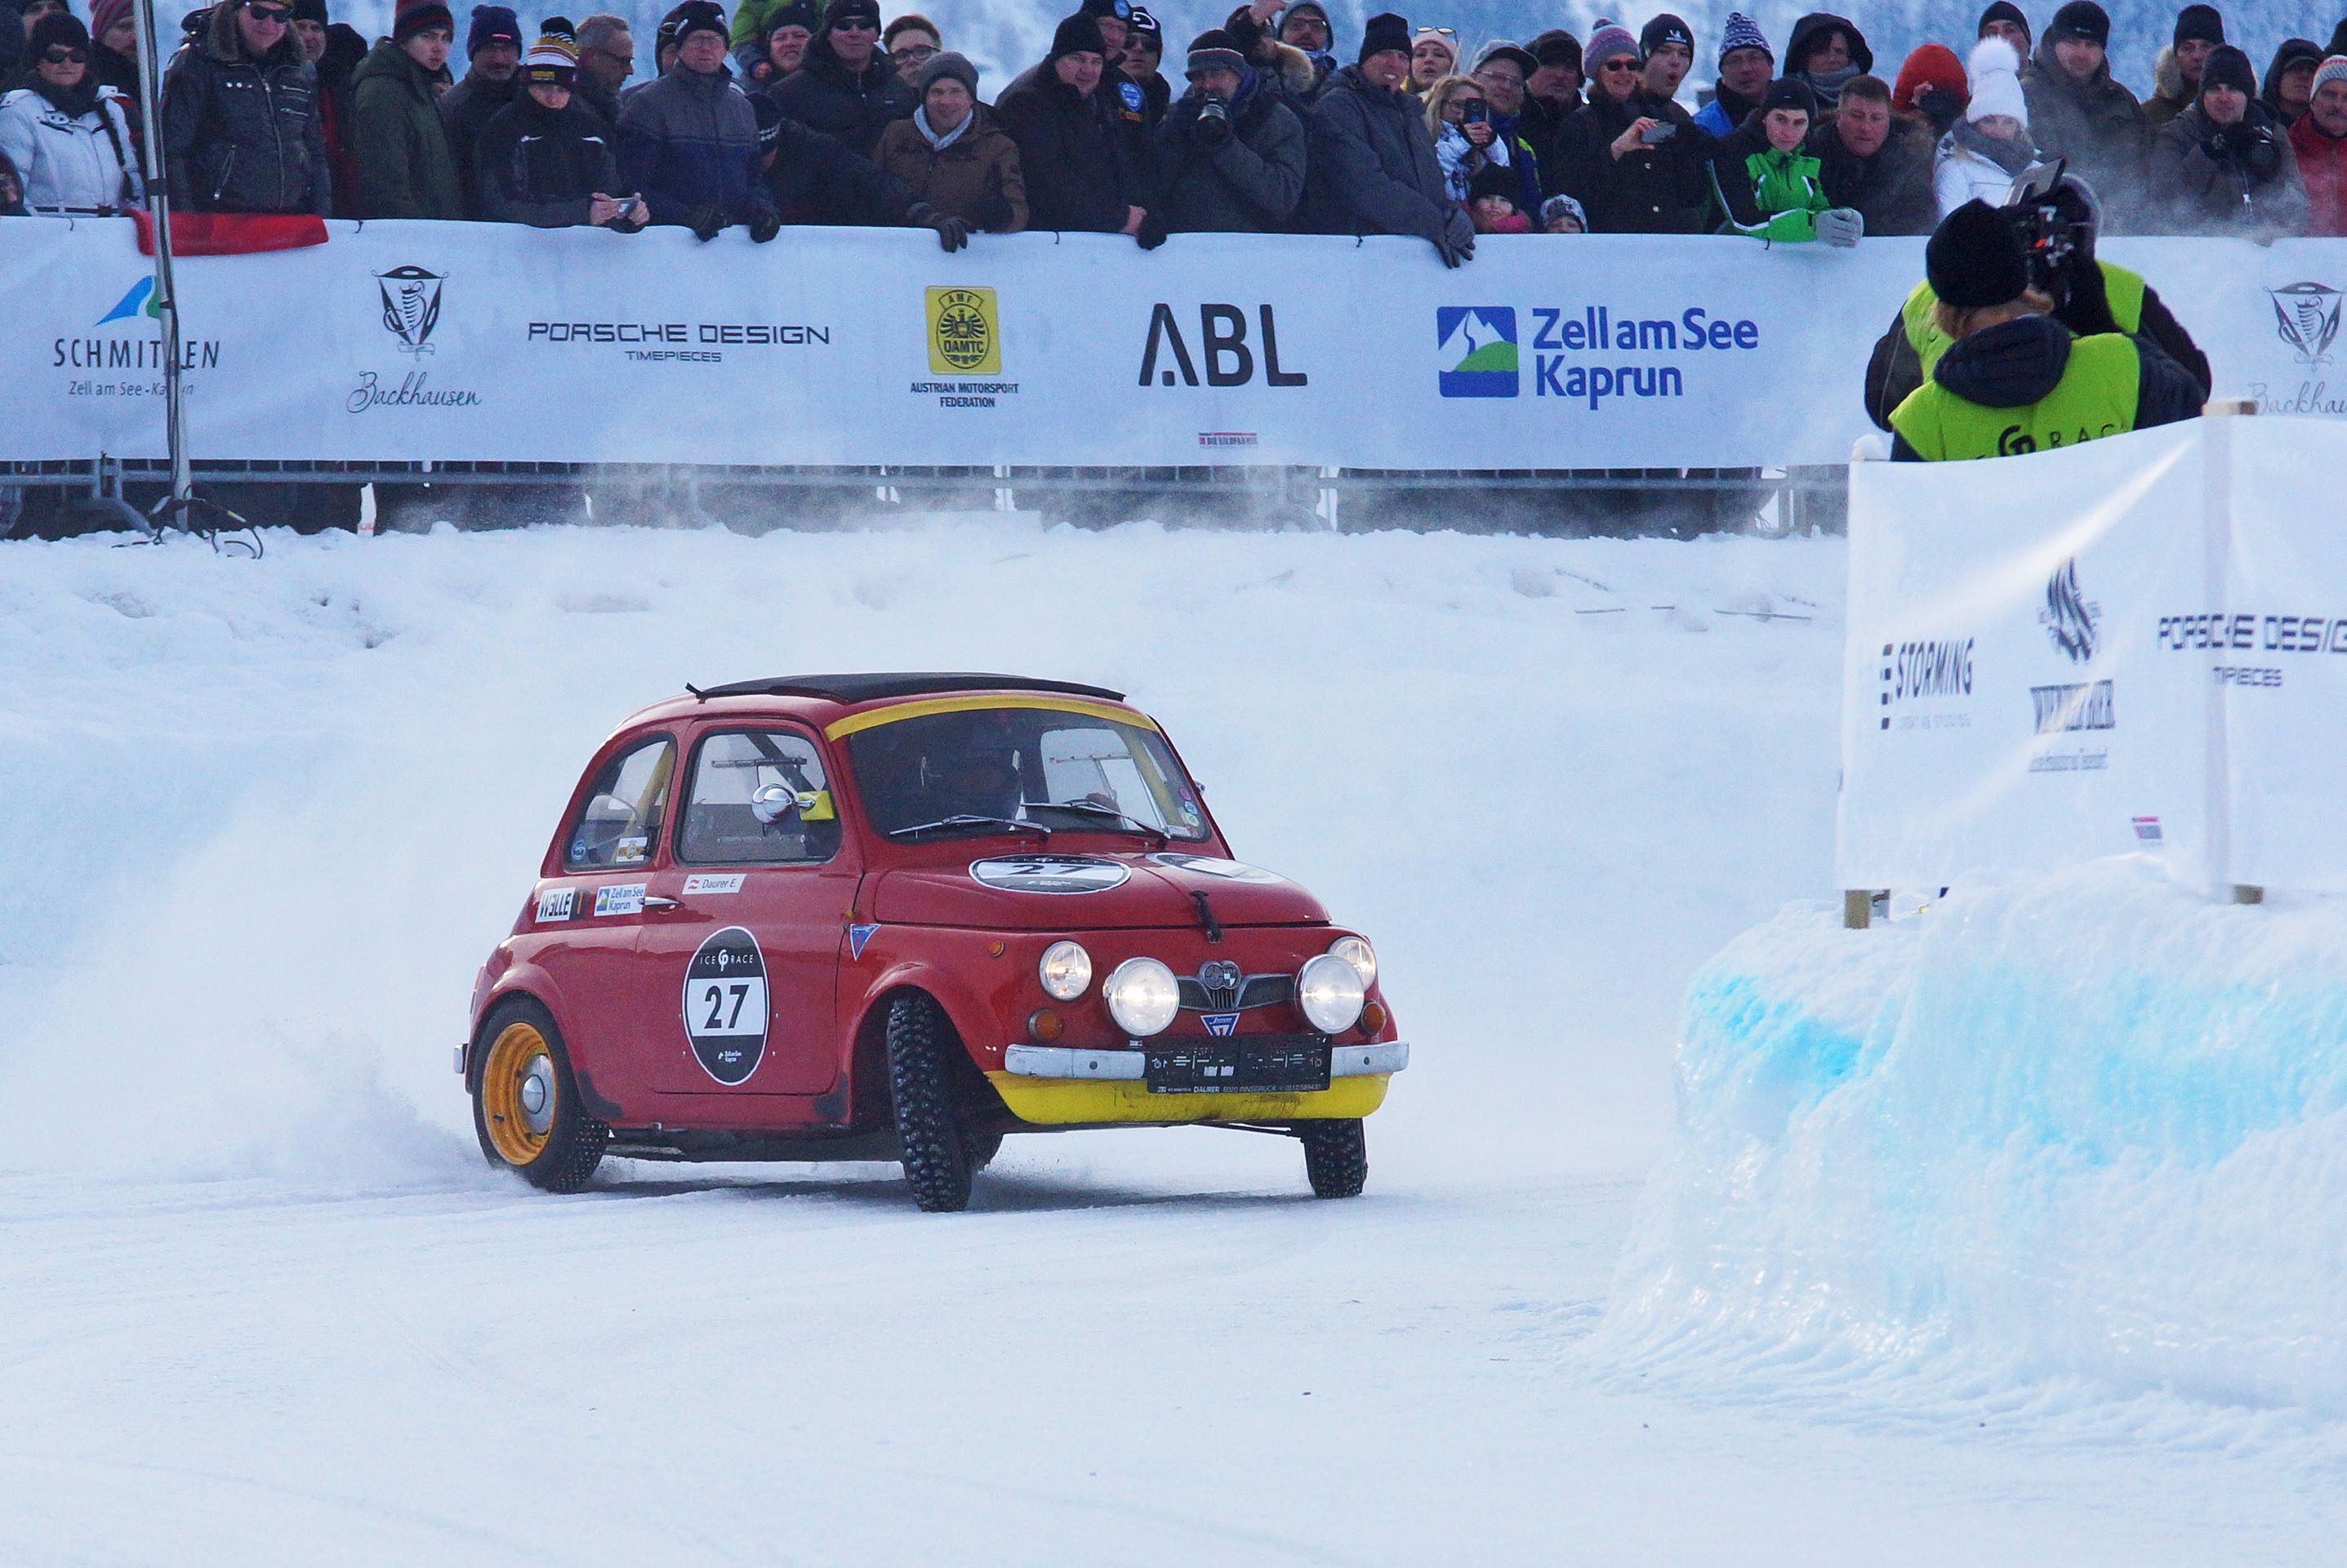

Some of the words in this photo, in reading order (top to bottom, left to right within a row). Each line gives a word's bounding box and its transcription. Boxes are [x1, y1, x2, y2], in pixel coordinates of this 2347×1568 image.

[949, 292, 973, 304] AMF
[528, 322, 688, 343] PORSCHE
[699, 324, 830, 345] DESIGN
[1531, 305, 1610, 350] Zell
[1615, 319, 1677, 350] am
[1682, 307, 1759, 350] See
[1138, 303, 1308, 387] ABL
[53, 337, 220, 369] SCHMITEN
[625, 350, 722, 363] TIMEPIECES
[69, 381, 91, 396] Zell
[96, 384, 116, 396] am
[911, 382, 955, 394] AUSTRIAN
[958, 383, 1020, 394] MOTORSPORT
[1536, 354, 1683, 411] Kaprun
[346, 370, 483, 414] Backhausen
[940, 397, 995, 408] FEDERATION
[1895, 635, 1975, 700] STORMING
[1008, 863, 1094, 875] 27
[701, 879, 729, 889] Daurer
[611, 888, 622, 899] Zell
[632, 887, 644, 898] See
[608, 901, 631, 914] Kaprun
[700, 955, 716, 965] ICE
[731, 954, 754, 965] RACE
[703, 984, 750, 1029] 27
[1193, 1085, 1220, 1094] DAURER
